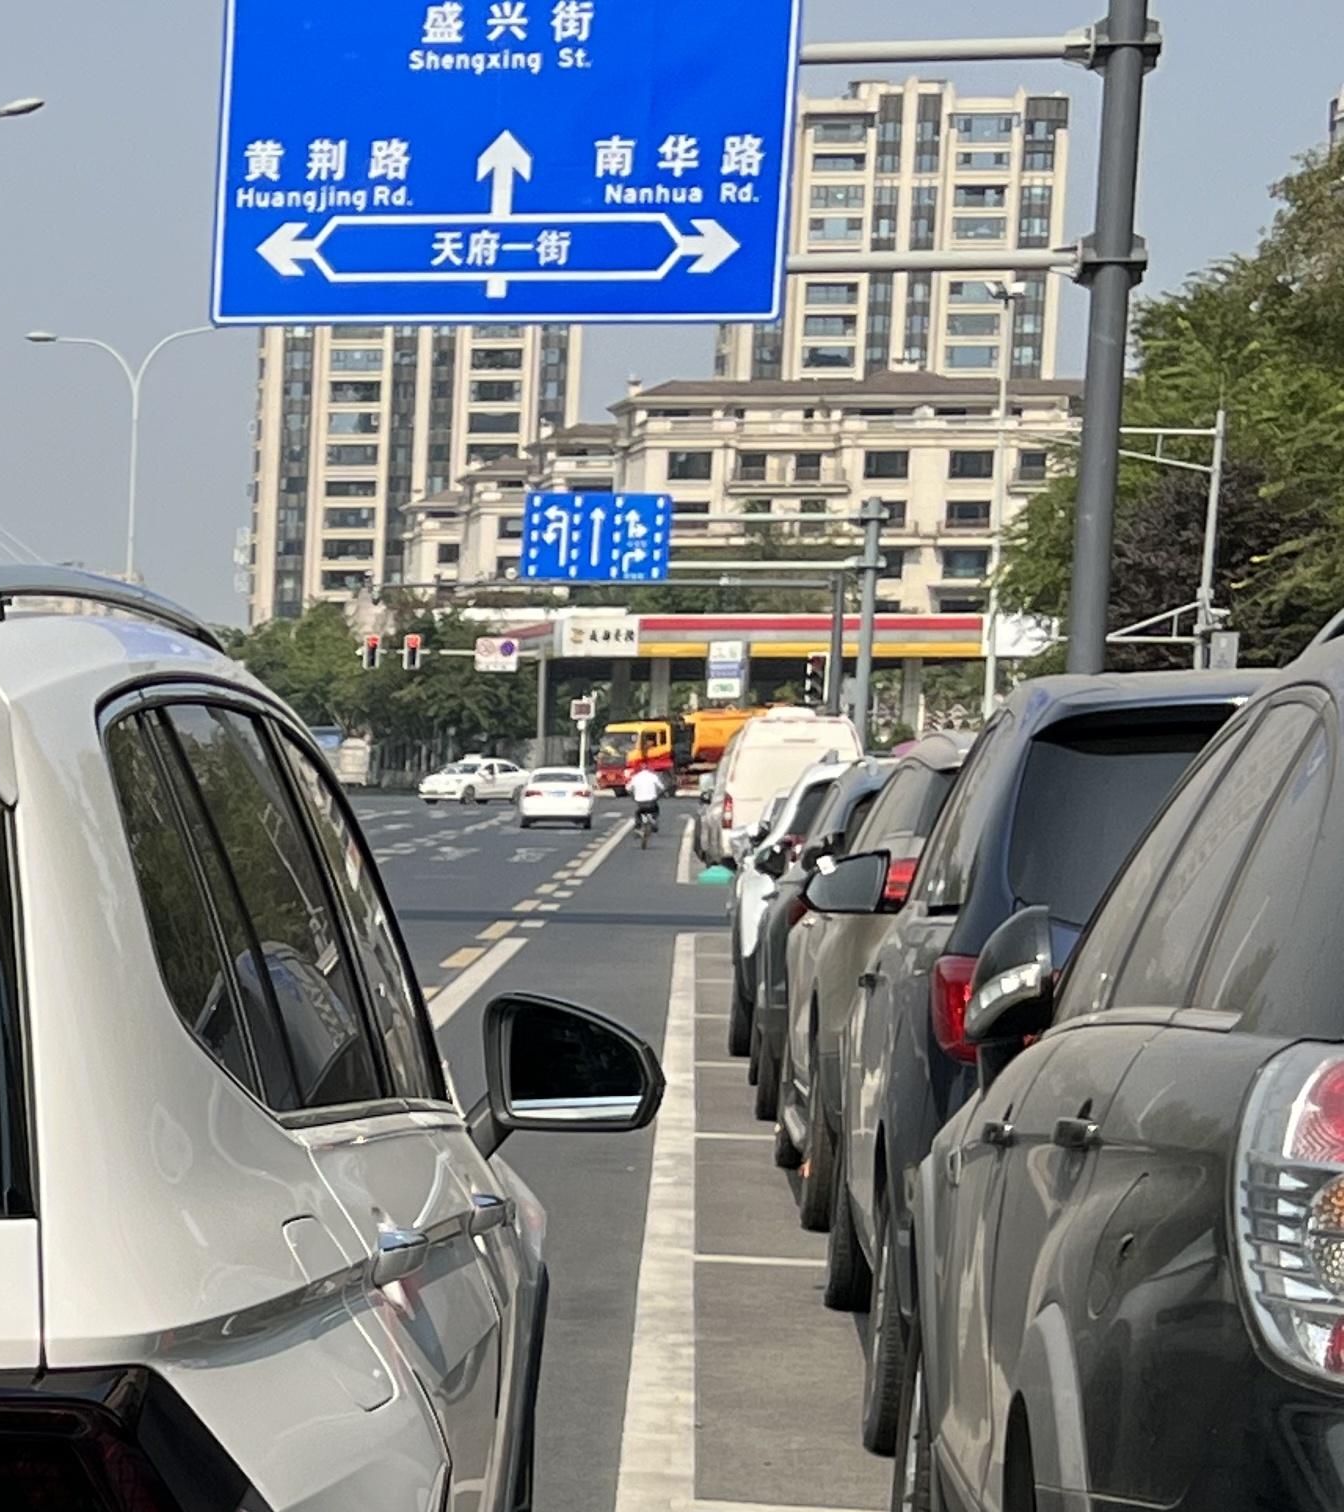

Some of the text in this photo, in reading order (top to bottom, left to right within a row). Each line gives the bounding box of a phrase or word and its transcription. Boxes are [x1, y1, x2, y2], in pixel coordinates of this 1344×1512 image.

[421, 1, 594, 43] 盛兴街
[409, 47, 593, 75] Shengxing St.
[244, 137, 411, 182] 黄荆路
[594, 134, 767, 178] 南华路
[236, 185, 414, 212] Huangjing Rd.
[604, 182, 760, 204] Nanhua Rd.
[430, 231, 572, 266] 天府一街
